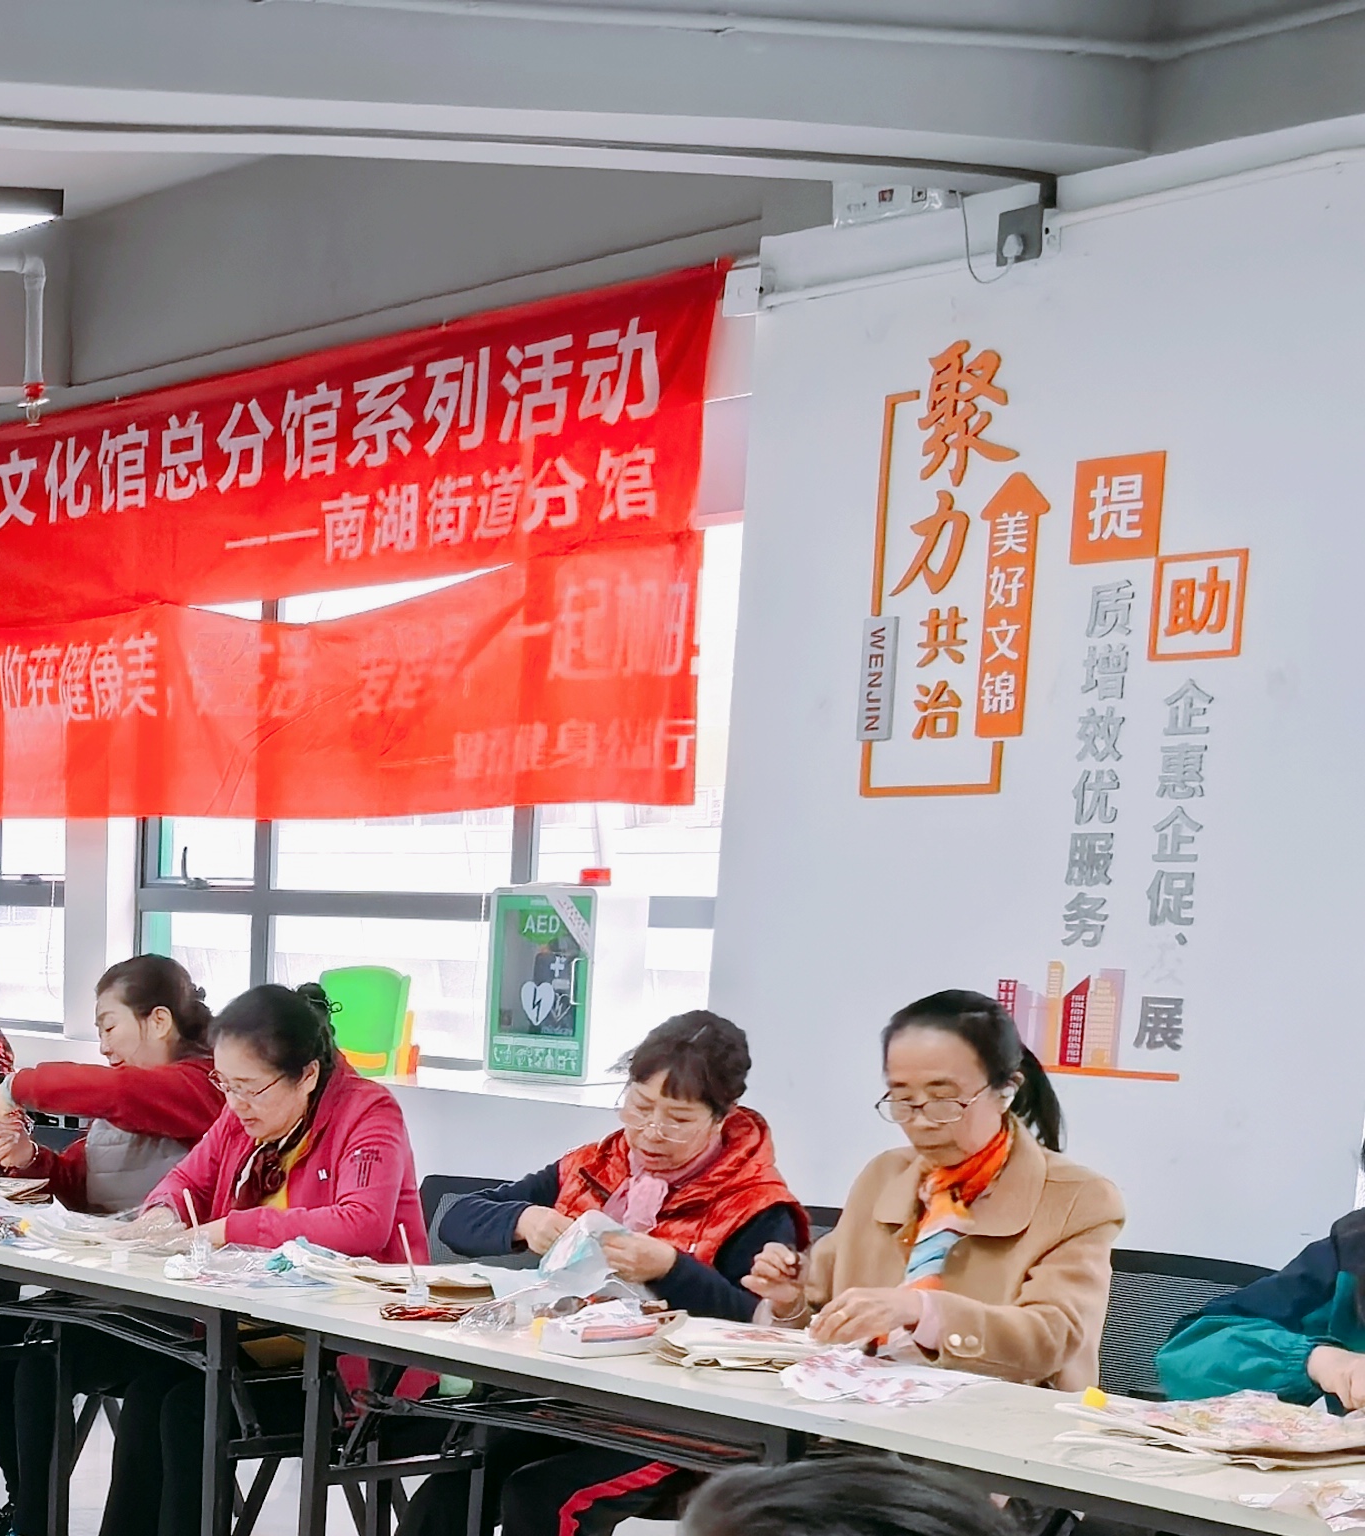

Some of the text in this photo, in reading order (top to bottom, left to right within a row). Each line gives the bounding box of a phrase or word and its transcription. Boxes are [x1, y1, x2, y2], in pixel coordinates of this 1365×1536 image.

[863, 625, 887, 733] WENJIN
[980, 511, 1029, 715] 美好文锦
[1132, 574, 1230, 1051] 助企惠企促展
[523, 914, 561, 934] AED
